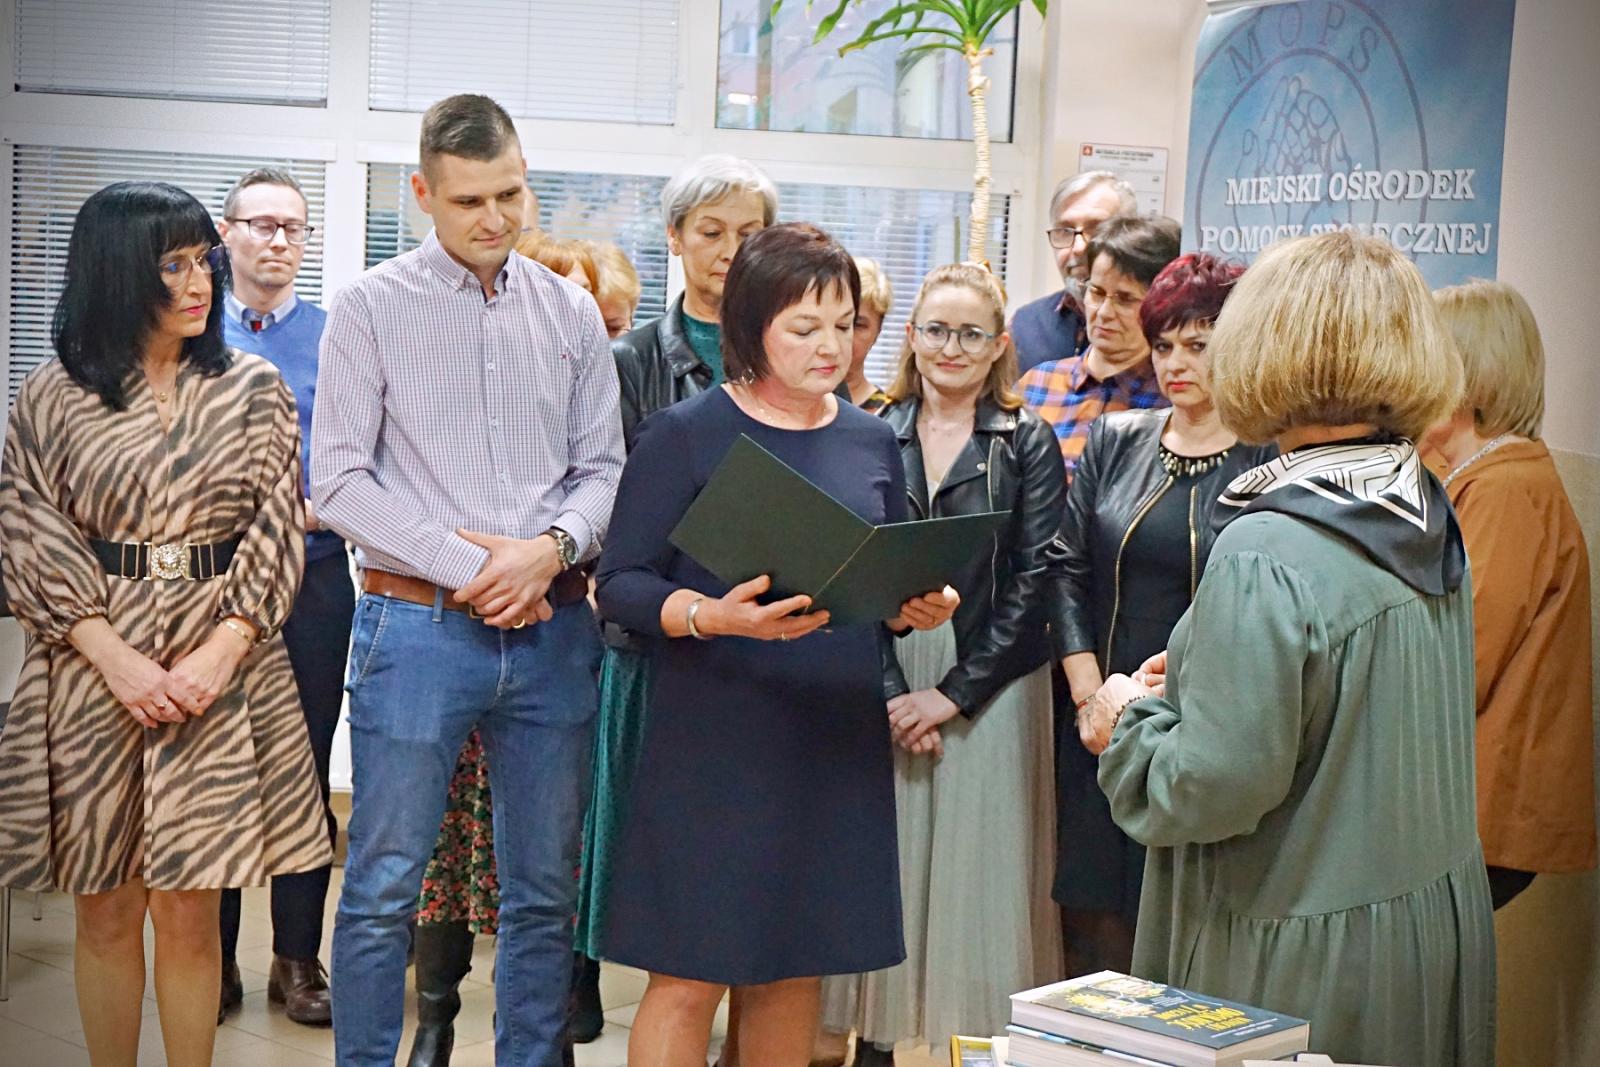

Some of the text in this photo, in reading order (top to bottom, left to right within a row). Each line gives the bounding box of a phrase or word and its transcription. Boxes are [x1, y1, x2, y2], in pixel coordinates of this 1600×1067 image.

[1226, 163, 1475, 205] MIEJSKI OŚRODEK
[1309, 223, 1492, 254] ECZNEJ
